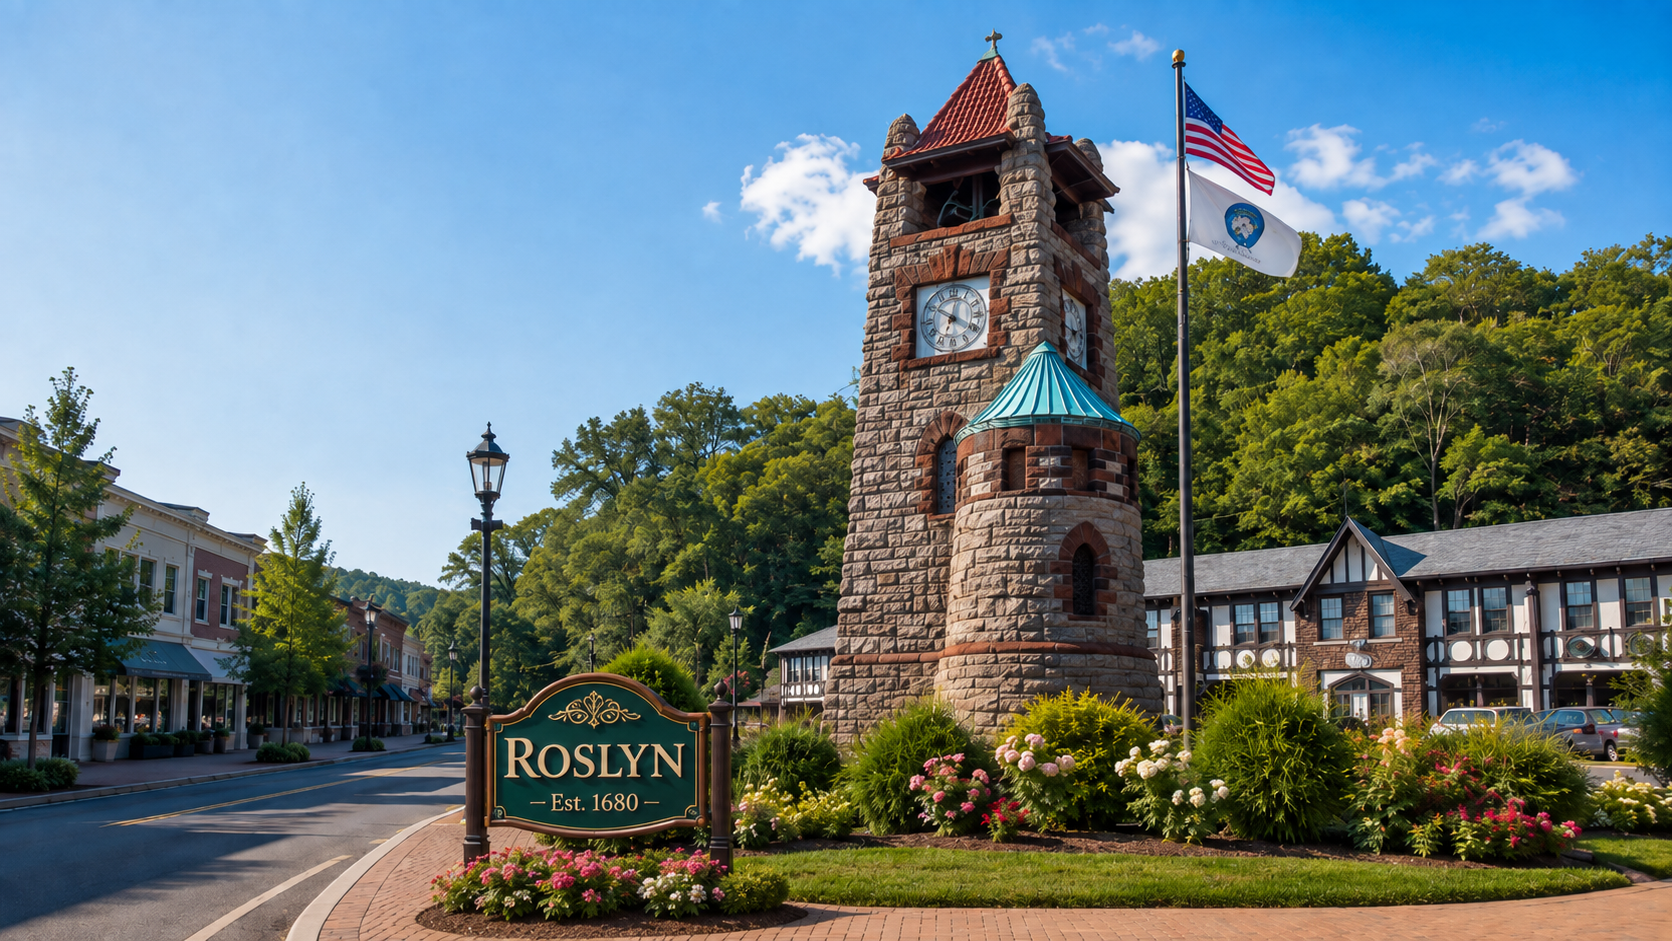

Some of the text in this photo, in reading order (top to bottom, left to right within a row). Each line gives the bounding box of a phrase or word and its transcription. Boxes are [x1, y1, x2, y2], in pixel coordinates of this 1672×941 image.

[504, 737, 685, 779] ROSLYN
[551, 793, 639, 812] Est. 1680
